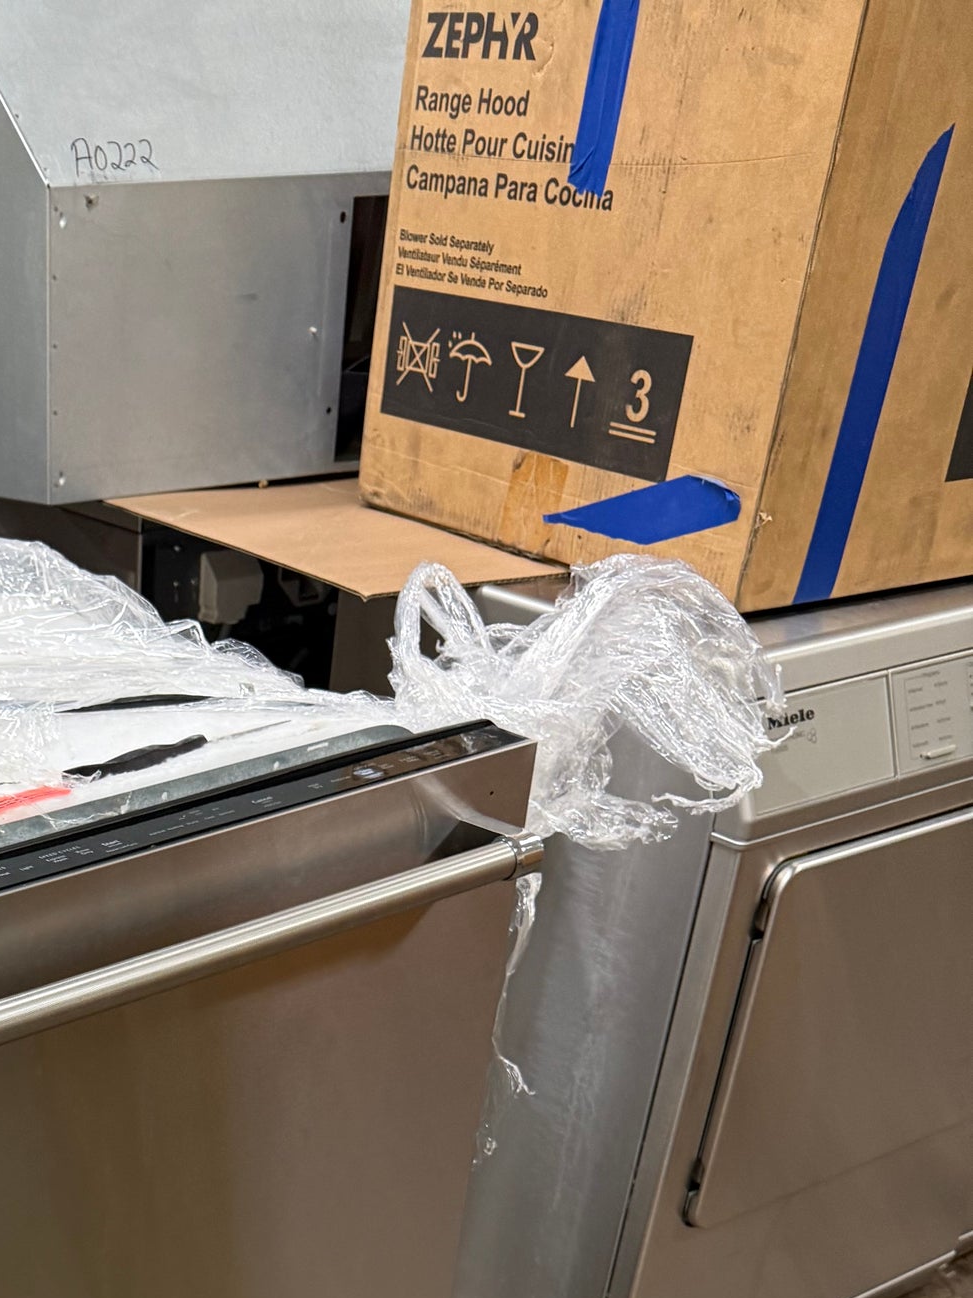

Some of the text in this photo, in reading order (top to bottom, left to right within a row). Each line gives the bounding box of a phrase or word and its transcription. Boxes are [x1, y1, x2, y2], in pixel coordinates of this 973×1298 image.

[421, 12, 539, 61] ZEPHYR
[415, 85, 530, 120] Range Hood
[410, 125, 576, 163] Hotte Pour Cuisin
[406, 164, 614, 211] Campana Para Cocina
[399, 228, 495, 256] Blower Sold Separately
[398, 246, 522, 276] Ventilateur Vendu Séparément
[395, 263, 548, 299] El Ventilador Se Vende Por Separado
[625, 369, 653, 423] 3
[767, 708, 815, 730] Miele
